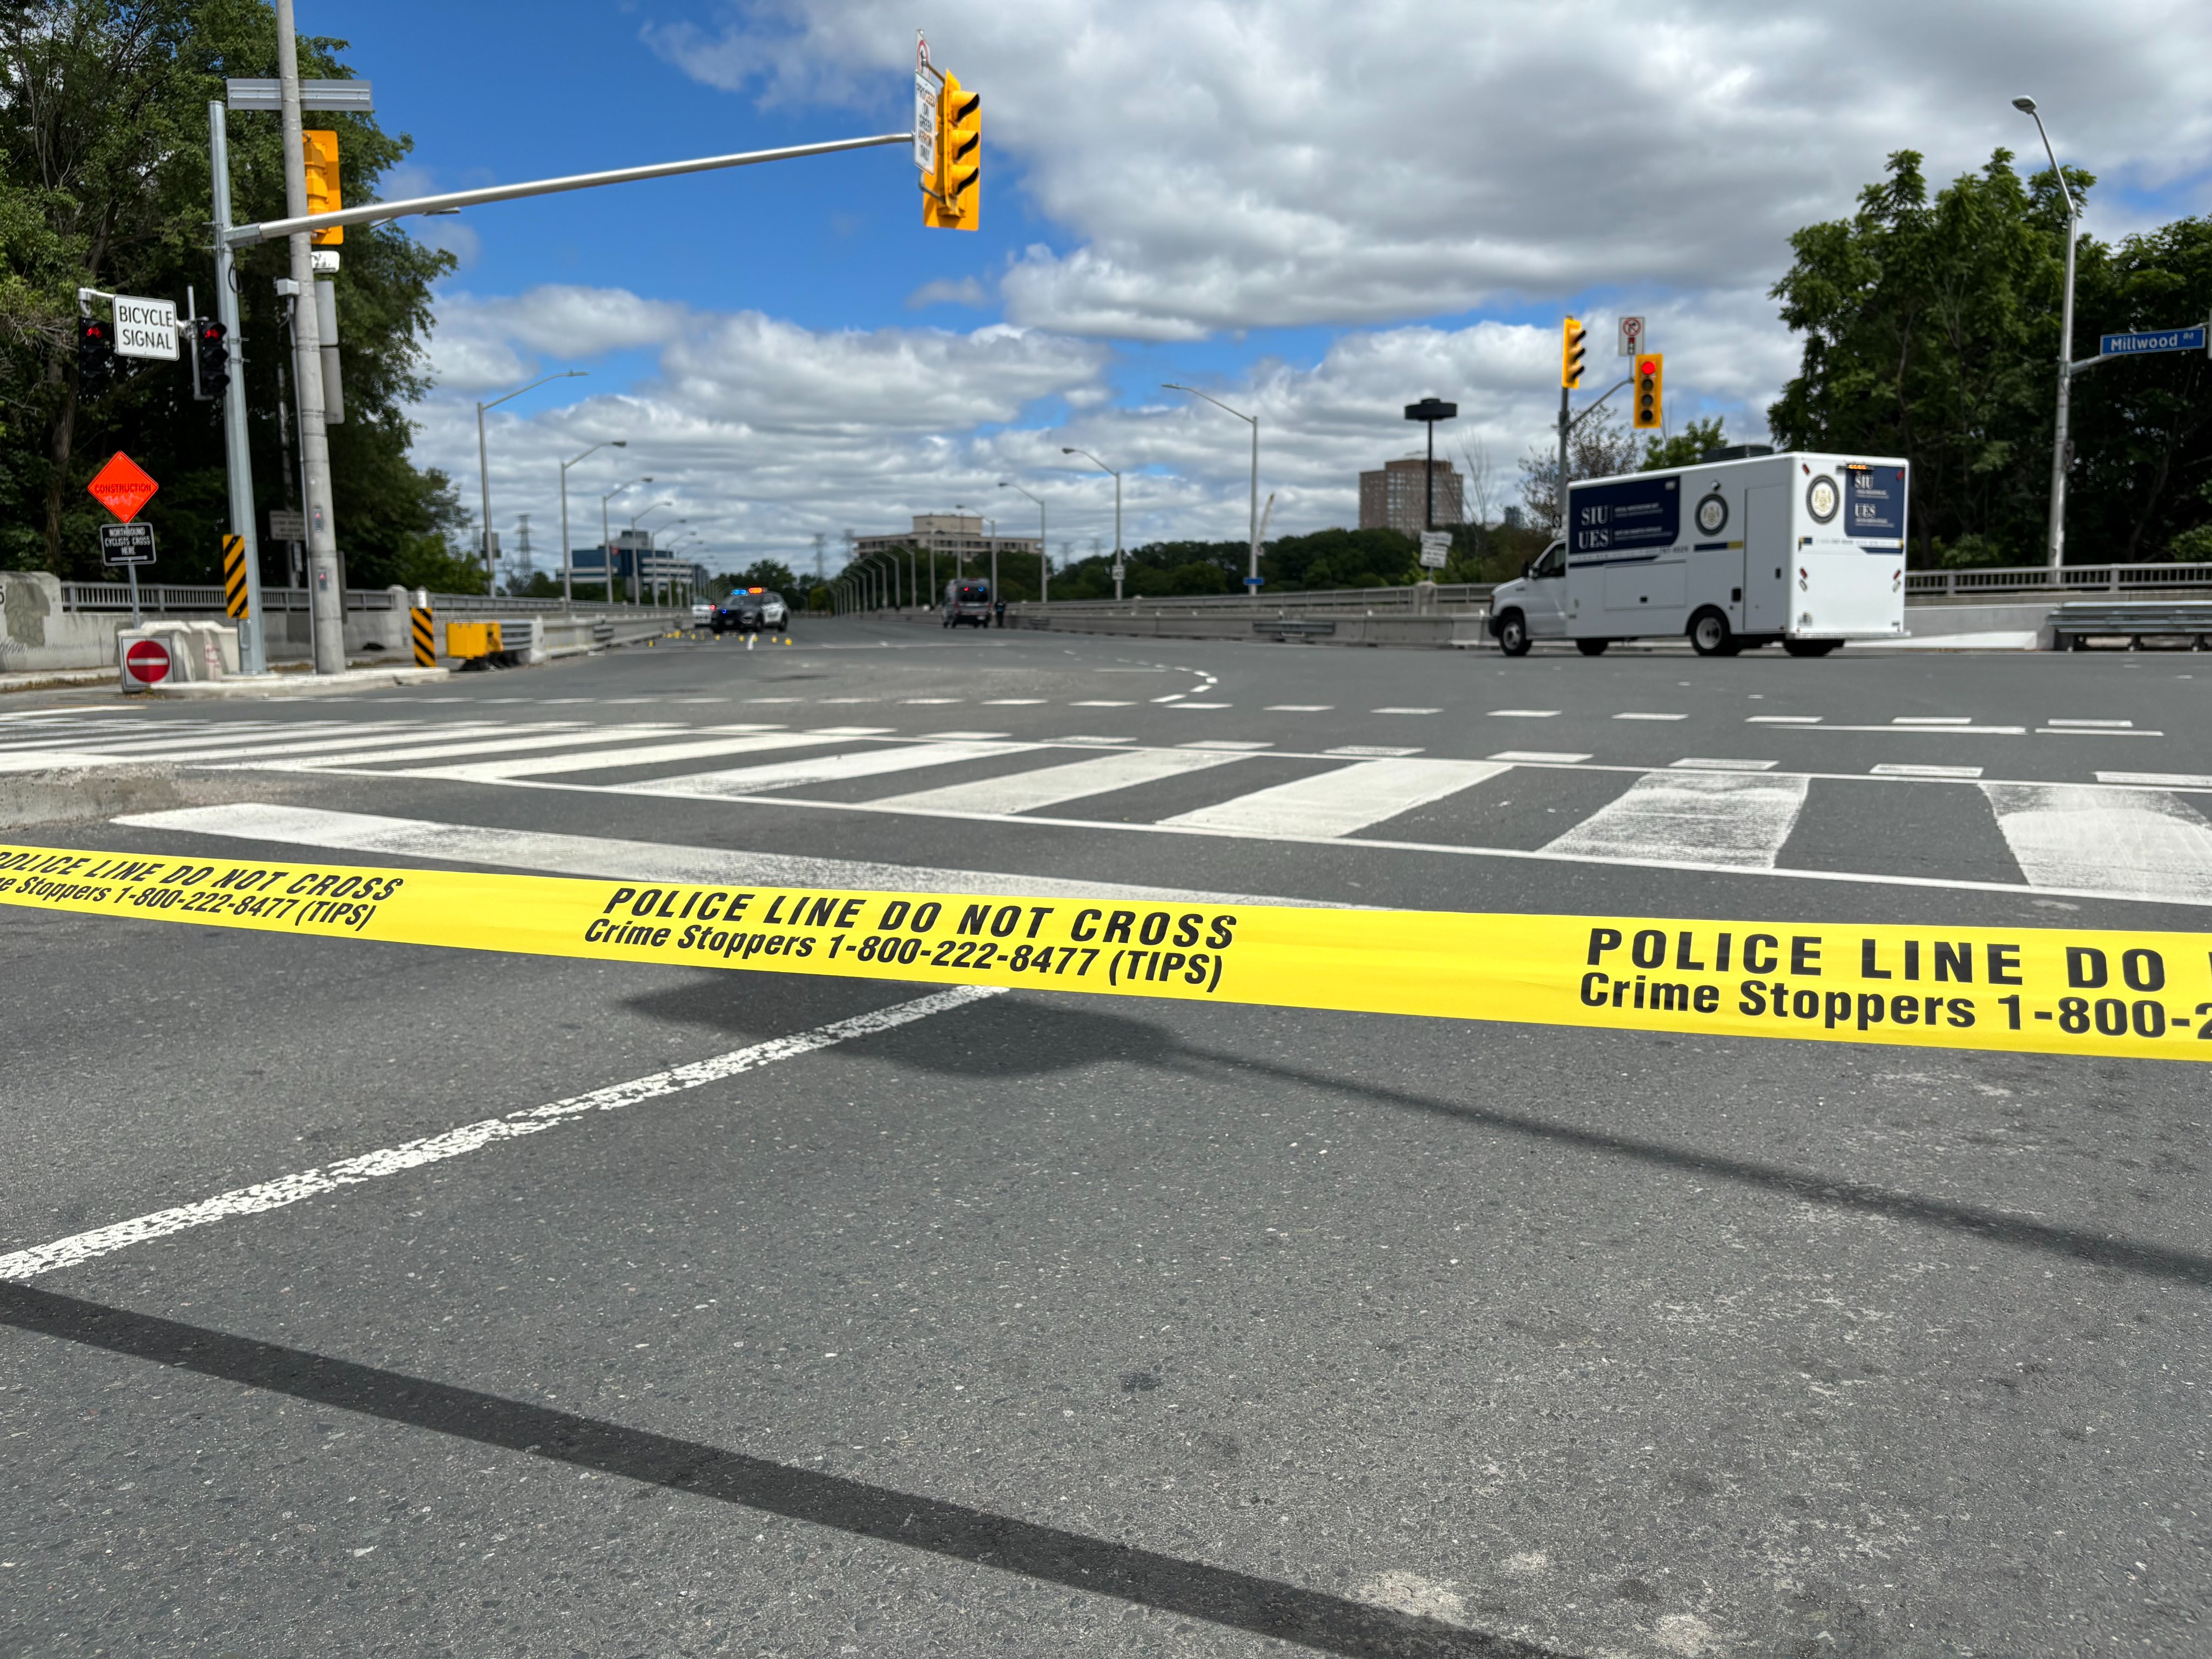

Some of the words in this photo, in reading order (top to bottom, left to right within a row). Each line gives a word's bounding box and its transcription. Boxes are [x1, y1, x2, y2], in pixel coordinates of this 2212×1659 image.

[119, 306, 173, 327] BICYCLE
[123, 328, 173, 350] SIGNAL
[2110, 333, 2178, 351] Millwood
[2183, 332, 2194, 340] Rd
[95, 483, 151, 494] CONSTRUCTION
[1854, 475, 1873, 489] SIU
[1581, 504, 1609, 525] SIU
[1854, 503, 1876, 518] UES
[105, 537, 130, 547] CYCLISTS
[132, 536, 151, 545] CROSS
[109, 527, 146, 537] NORTHBOUND
[1578, 528, 1609, 549] UES
[121, 545, 136, 556] HERE
[83, 860, 166, 881] LINE
[159, 866, 206, 886] DO
[215, 869, 290, 892] NOT
[286, 873, 404, 901] CROSS
[16, 876, 112, 902] Stoppers
[113, 886, 296, 919] 1-800-222-8477
[295, 900, 377, 932] (TIPS)
[603, 887, 756, 922] POLICE
[763, 895, 867, 928] LINE
[878, 900, 942, 933] DO
[956, 904, 1055, 939] NOT
[1071, 909, 1237, 949] CROSS
[584, 919, 671, 947] Crime
[678, 924, 816, 959] Stoppers
[828, 934, 1100, 976] 1-800-222-8477
[1109, 949, 1223, 993] (TIPS)
[1587, 928, 1822, 976] POLICE
[1862, 939, 2023, 986] LINE
[2065, 946, 2166, 992] DO
[1580, 972, 1719, 1013] Crime
[1739, 980, 1976, 1030] Stoppers
